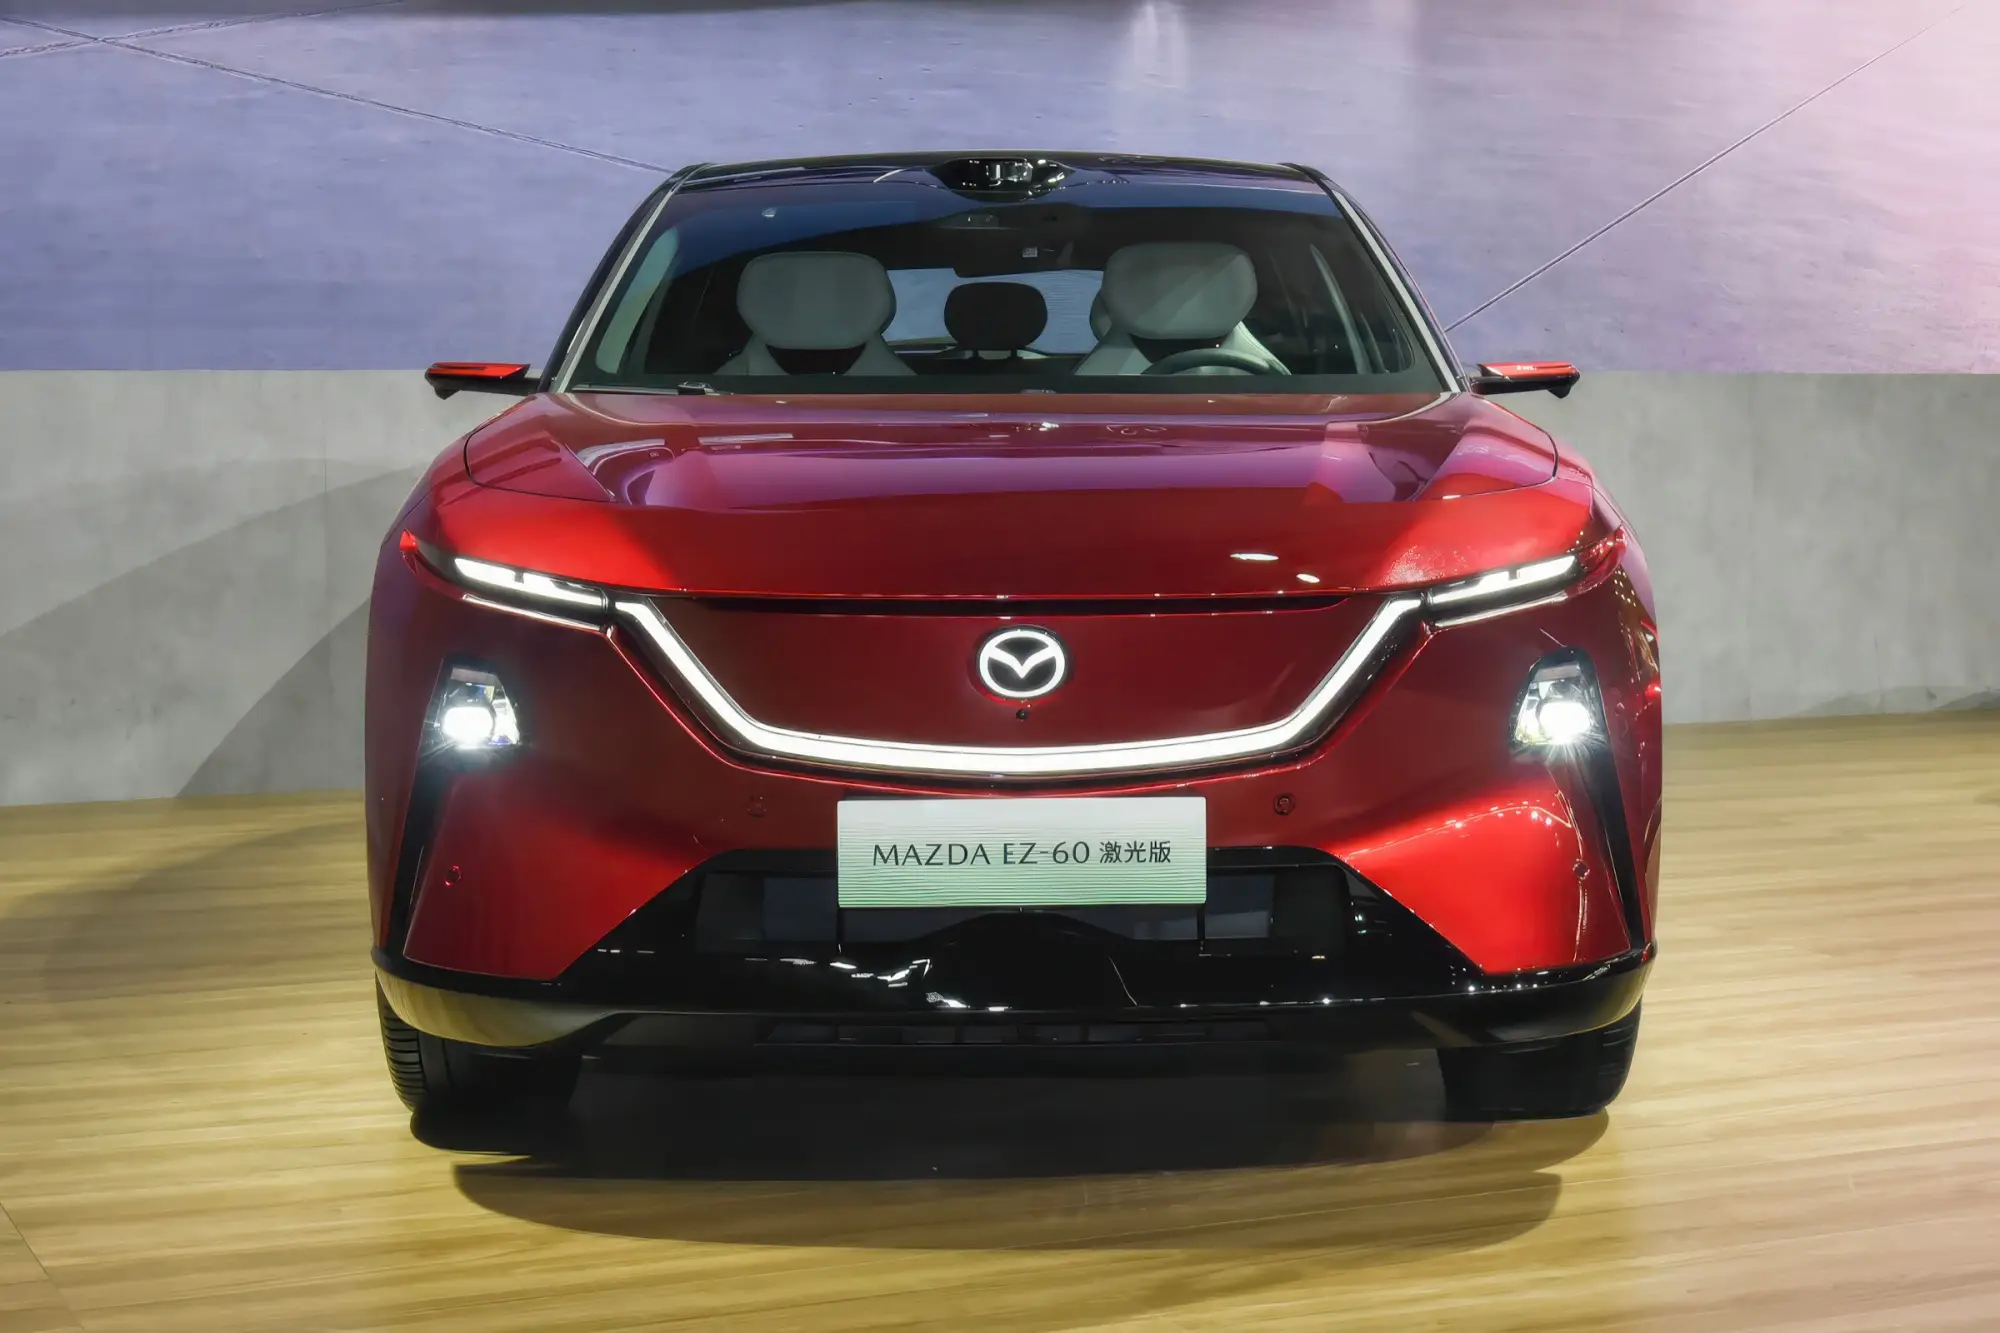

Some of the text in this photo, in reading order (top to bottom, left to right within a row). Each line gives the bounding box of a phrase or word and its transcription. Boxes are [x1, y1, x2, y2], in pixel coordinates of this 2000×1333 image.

[872, 840, 1171, 866] MAZDA EZ-60 激光版
